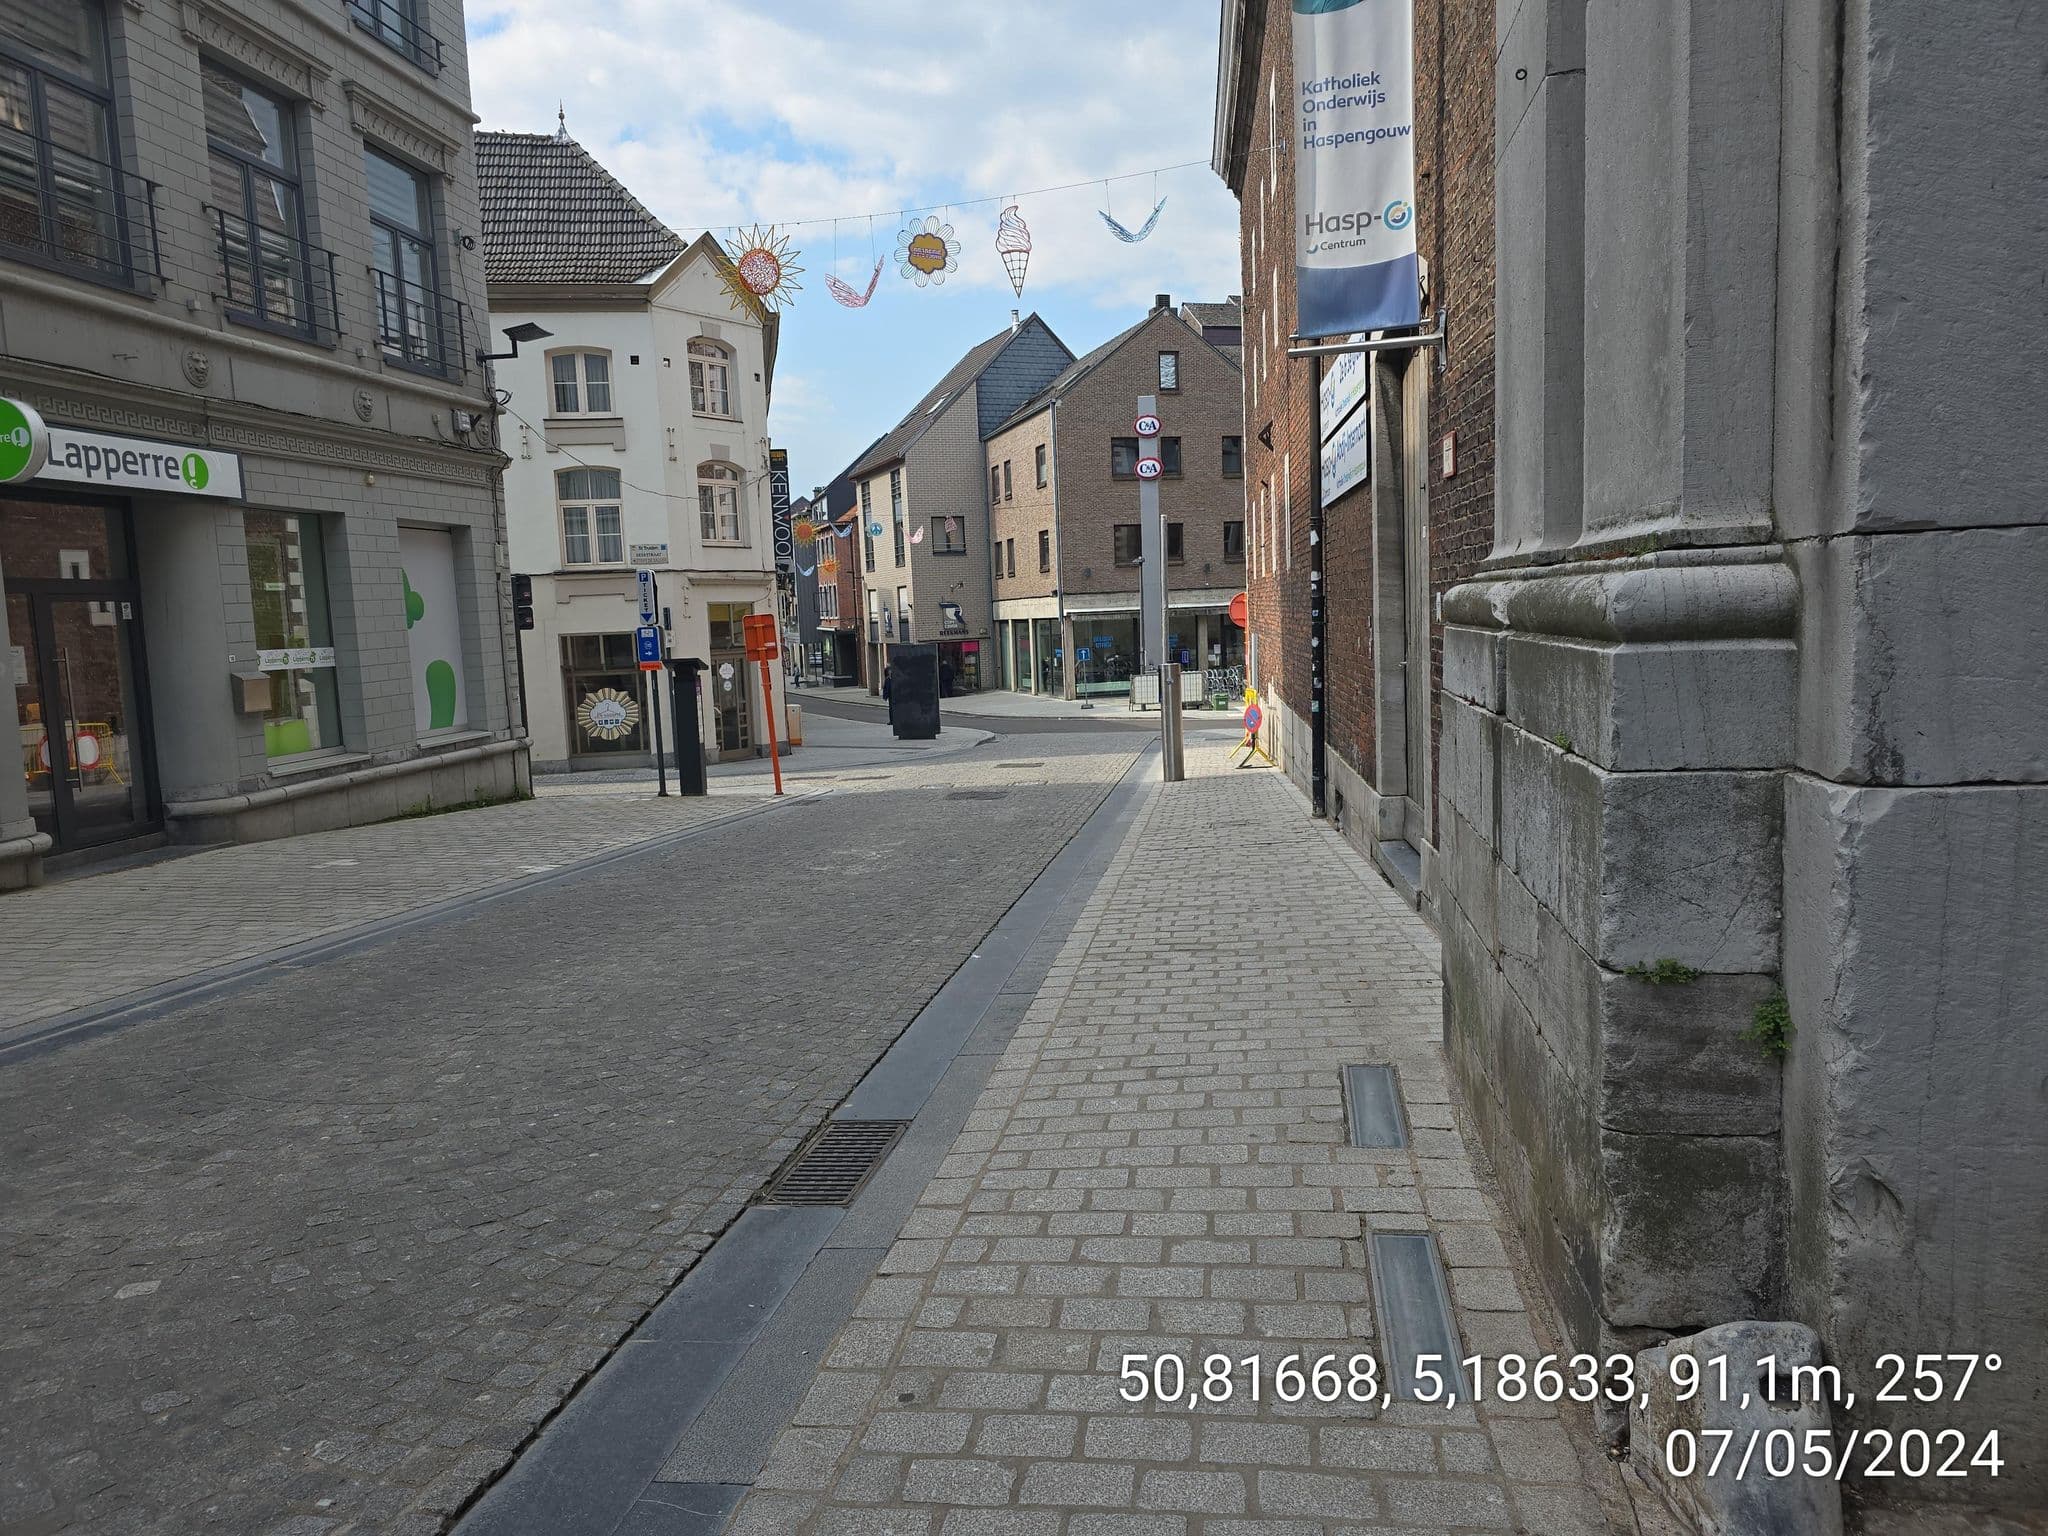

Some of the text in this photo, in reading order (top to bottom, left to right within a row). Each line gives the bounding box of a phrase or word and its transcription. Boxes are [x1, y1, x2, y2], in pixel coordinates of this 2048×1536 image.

[1302, 71, 1381, 96] Katholiek
[1302, 90, 1386, 113] Onderwijs
[1302, 118, 1317, 132] in
[1303, 125, 1411, 149] Haspengouw
[1320, 238, 1366, 251] Centrum
[1138, 421, 1157, 431] C&A
[1139, 463, 1158, 473] C&A
